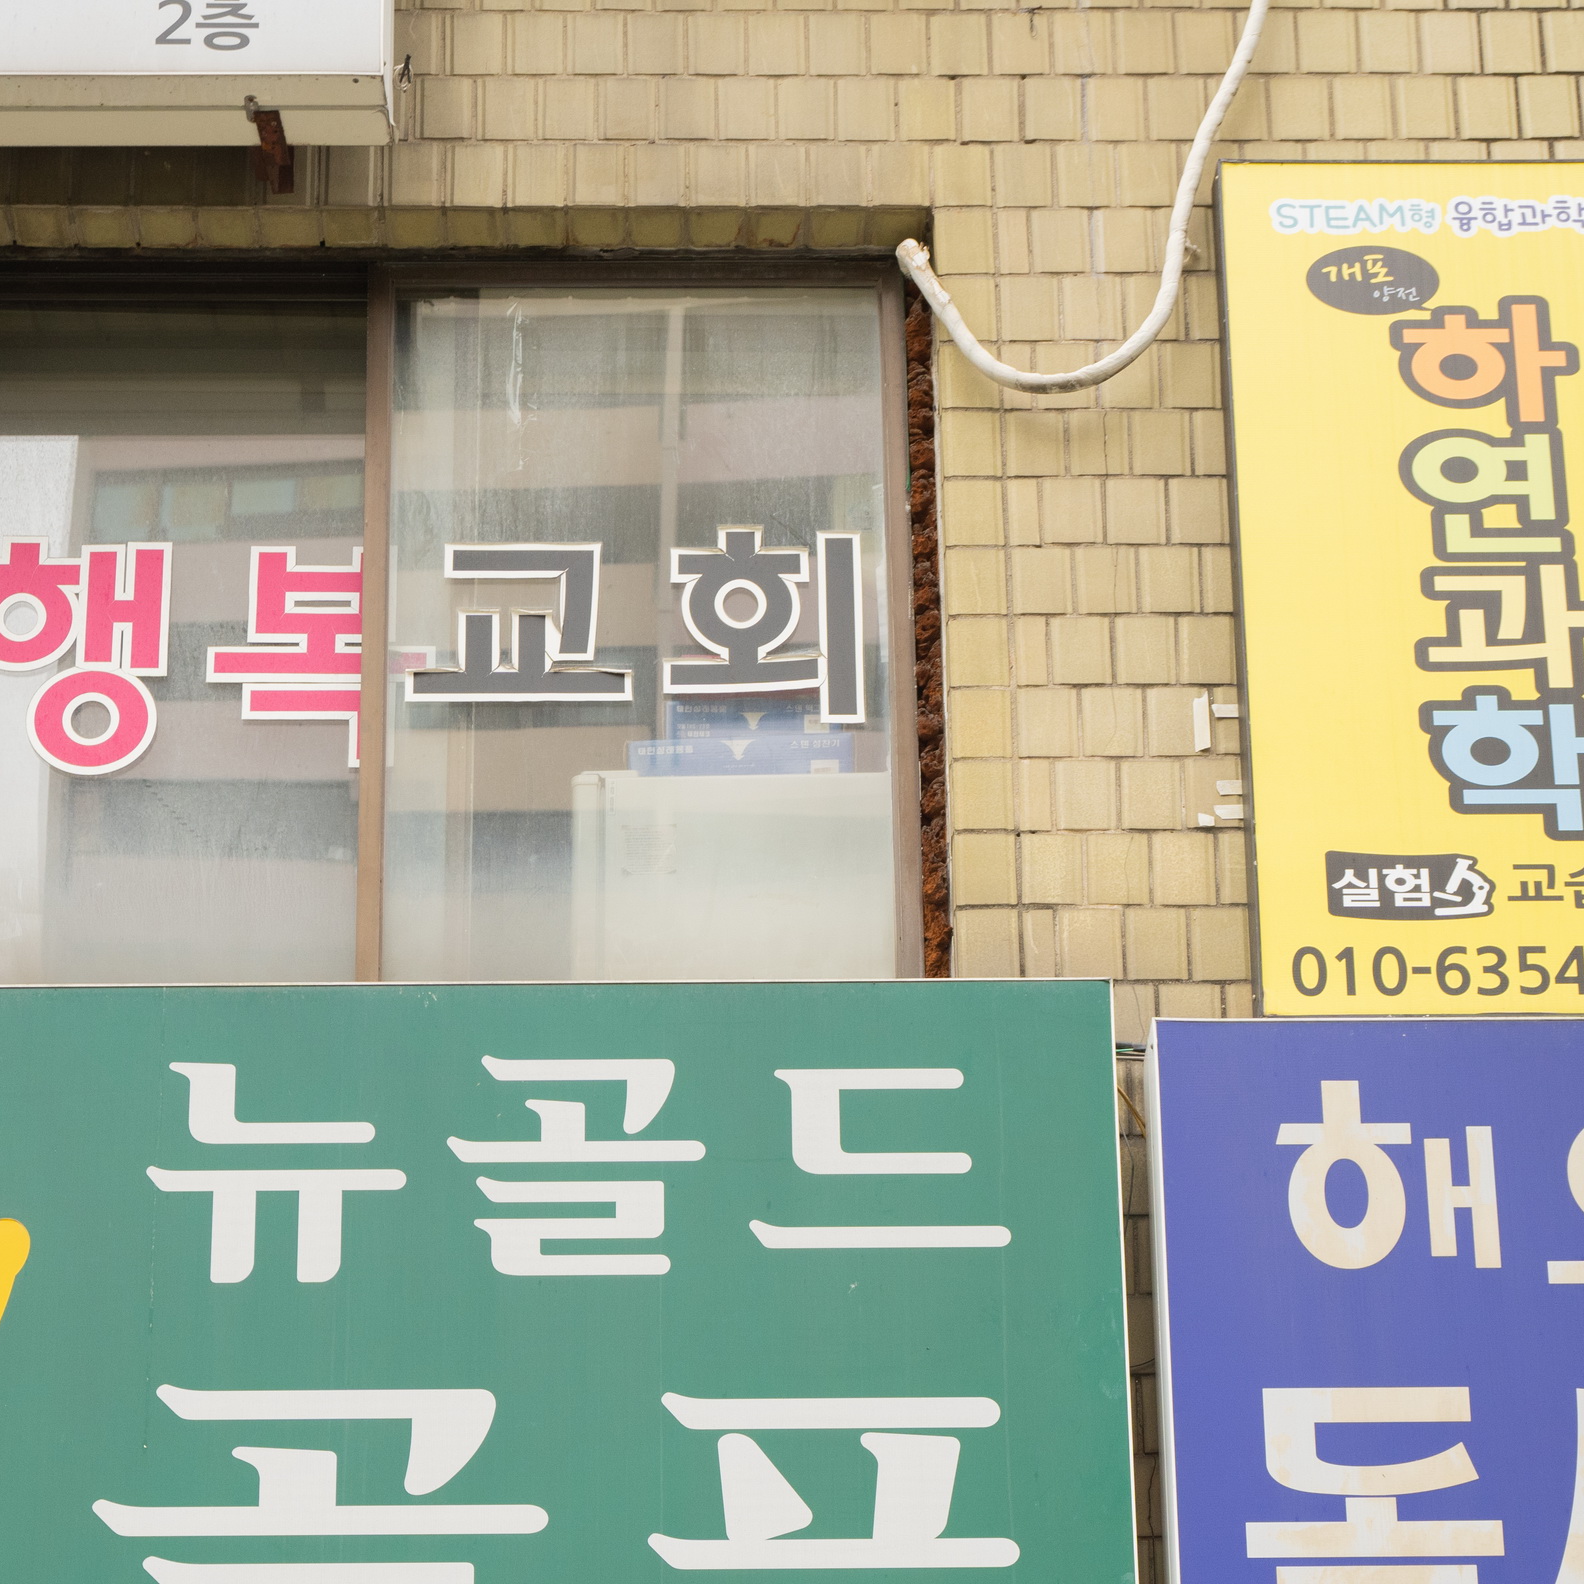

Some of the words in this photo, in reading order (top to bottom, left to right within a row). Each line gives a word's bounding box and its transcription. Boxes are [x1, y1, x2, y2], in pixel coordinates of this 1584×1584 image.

[155, 0, 259, 51] 2층
[1322, 254, 1394, 283] 개포
[146, 1054, 1012, 1284] 뉴골드
